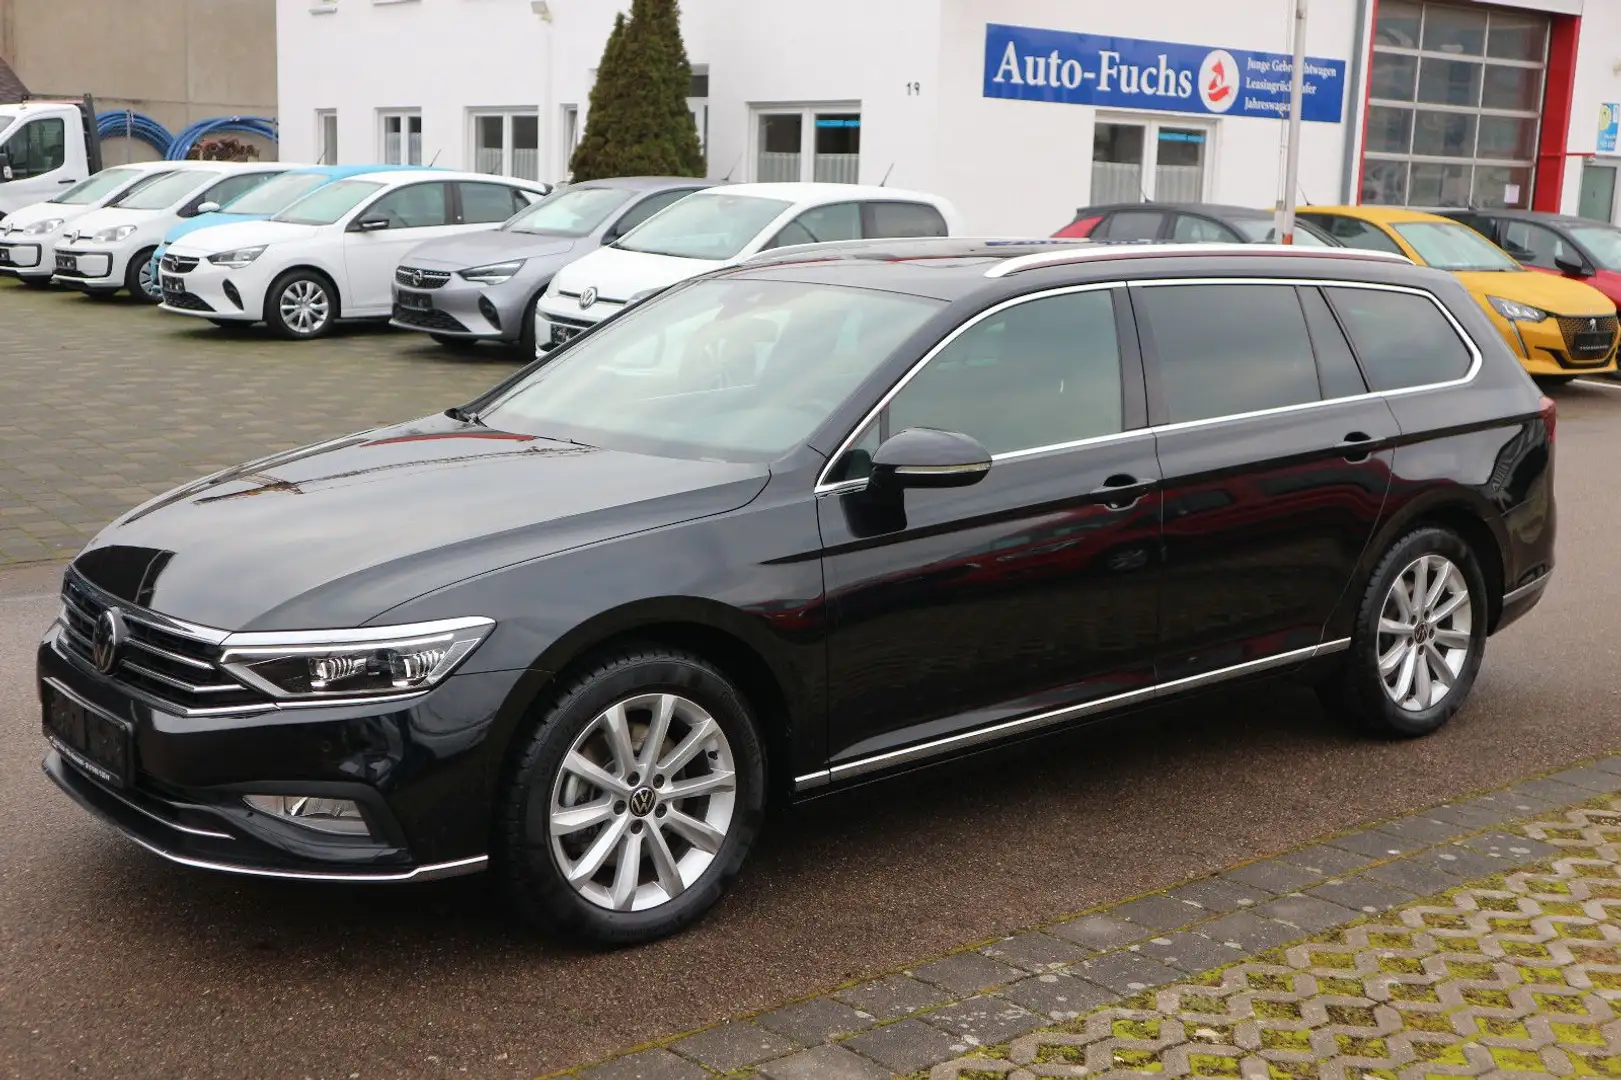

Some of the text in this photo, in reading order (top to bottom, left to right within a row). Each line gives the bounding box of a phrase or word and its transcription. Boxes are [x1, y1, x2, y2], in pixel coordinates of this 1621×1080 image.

[992, 40, 1193, 99] Auto-Fuchs
[1247, 57, 1337, 80] Junge Gebrhtwagen
